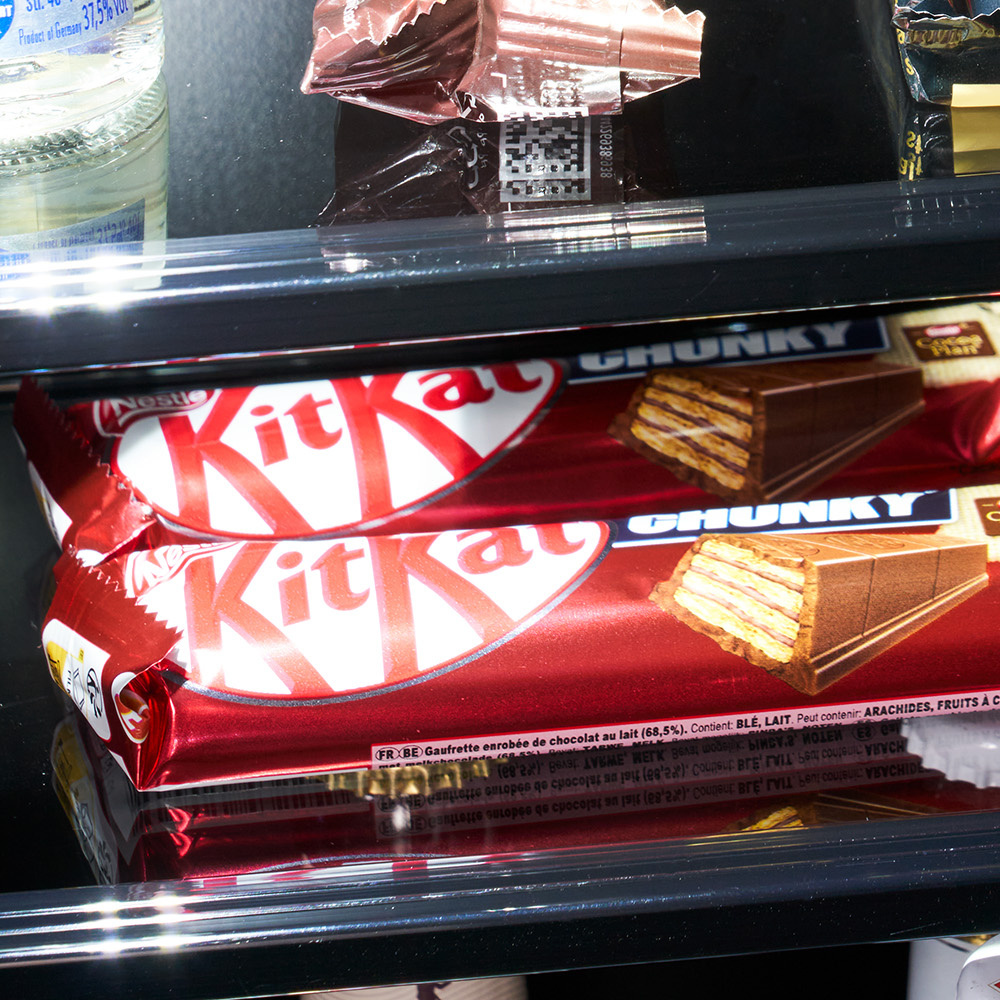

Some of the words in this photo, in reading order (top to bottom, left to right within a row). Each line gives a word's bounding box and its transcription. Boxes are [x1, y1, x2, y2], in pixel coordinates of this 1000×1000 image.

[18, 28, 45, 46] Product
[47, 25, 54, 41] of
[55, 21, 82, 38] Germany
[578, 321, 852, 372] CHUNKY
[915, 333, 984, 348] Cocoa
[931, 344, 979, 356] Plan
[627, 490, 926, 535] CHUNKY
[378, 749, 394, 760] FR
[402, 746, 419, 758] BE
[425, 742, 480, 757] Gaufrette
[483, 739, 530, 754] enrobée
[532, 737, 546, 750] de
[549, 731, 600, 746] chocolat
[602, 731, 616, 742] au
[619, 729, 639, 741] lait
[641, 724, 688, 740] (68,5%).
[690, 720, 733, 733] Contient:
[736, 715, 761, 730] BLÉ,
[765, 714, 794, 727] LAIT.
[797, 712, 819, 724] Peut
[820, 709, 862, 722] contenir:
[864, 700, 934, 718] ARACHIDES,
[937, 697, 979, 710] FRUITS
[981, 693, 990, 706] À
